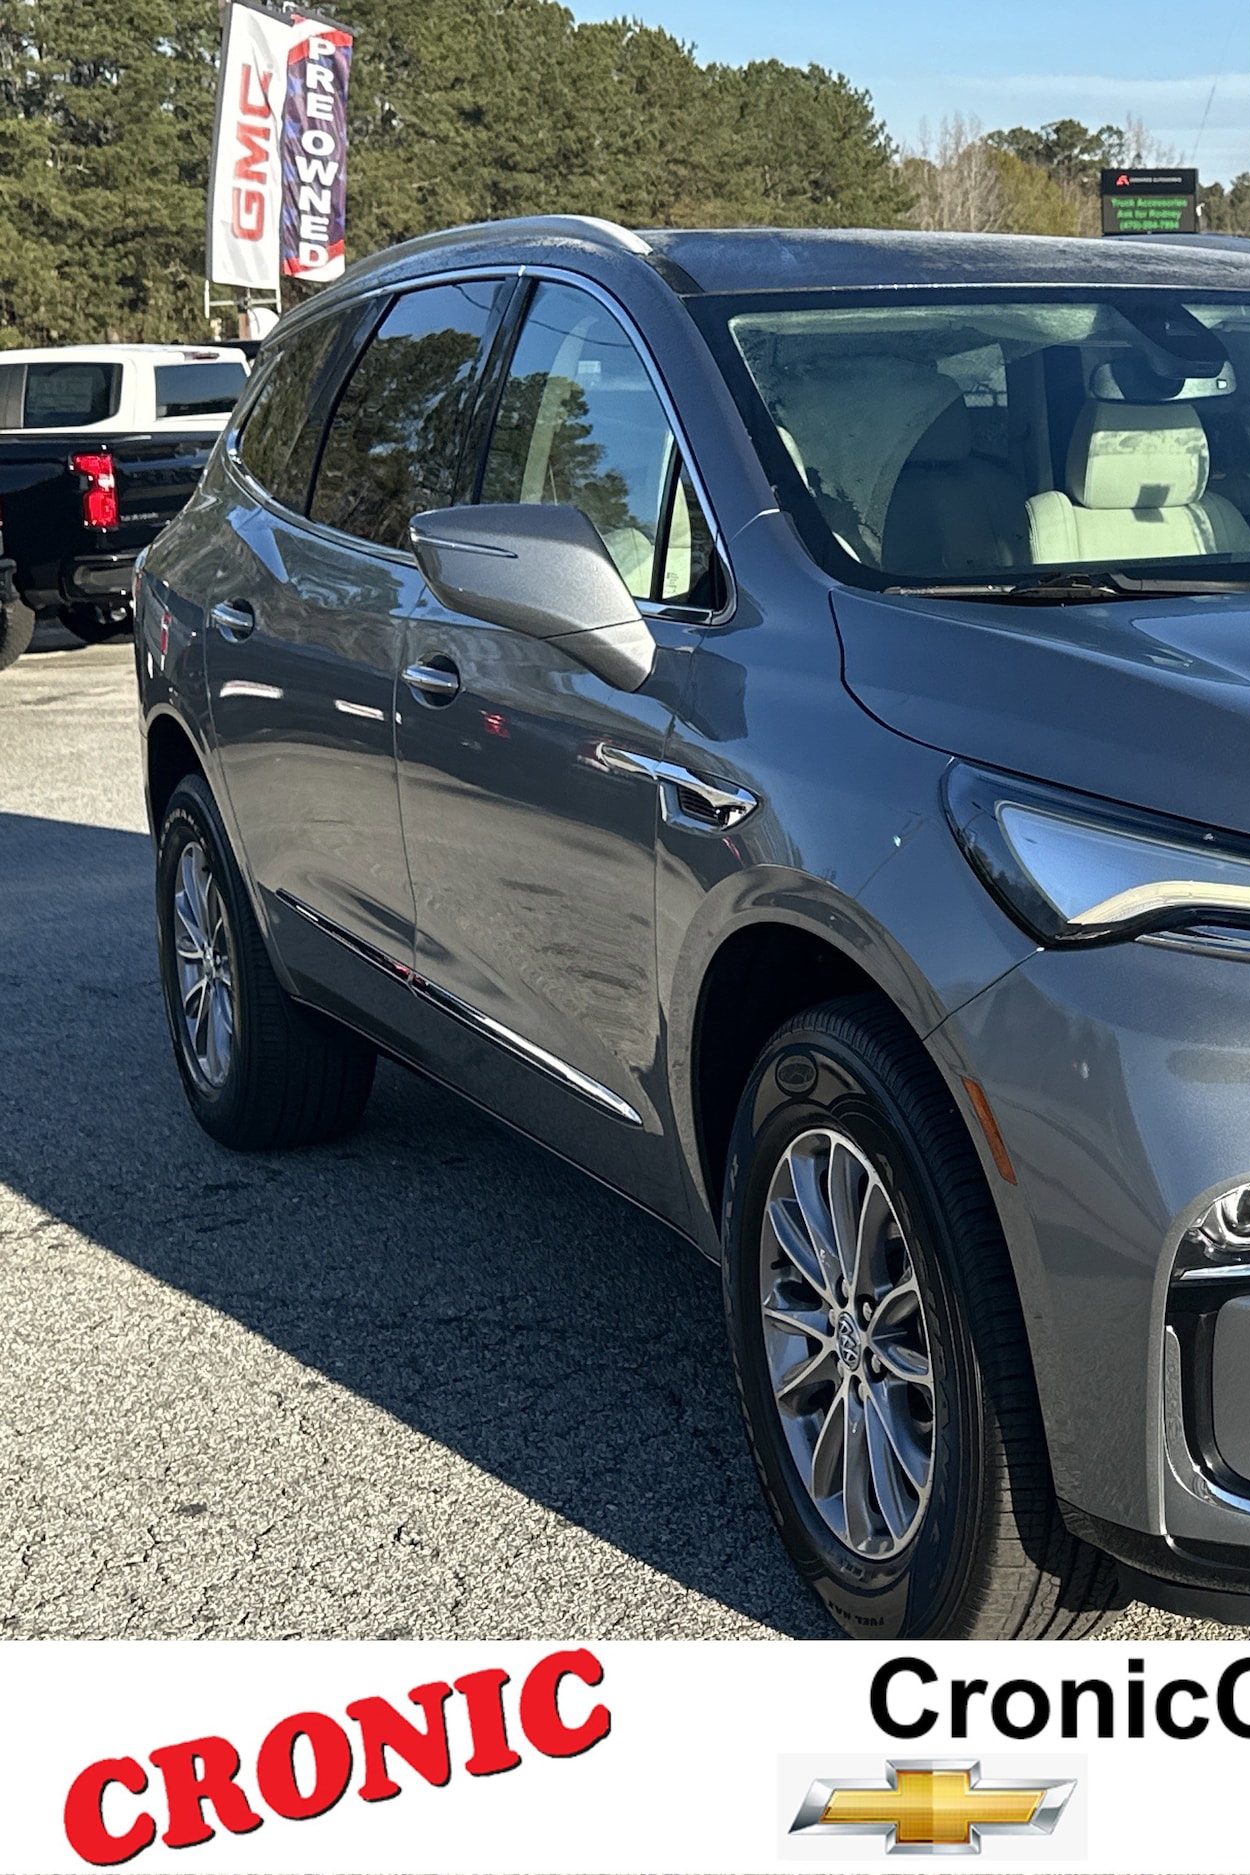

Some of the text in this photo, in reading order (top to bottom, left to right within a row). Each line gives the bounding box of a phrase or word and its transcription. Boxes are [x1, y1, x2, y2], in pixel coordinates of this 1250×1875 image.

[231, 63, 273, 242] GMC
[295, 36, 338, 268] PRE OWNED
[855, 1614, 884, 1626] FUEL
